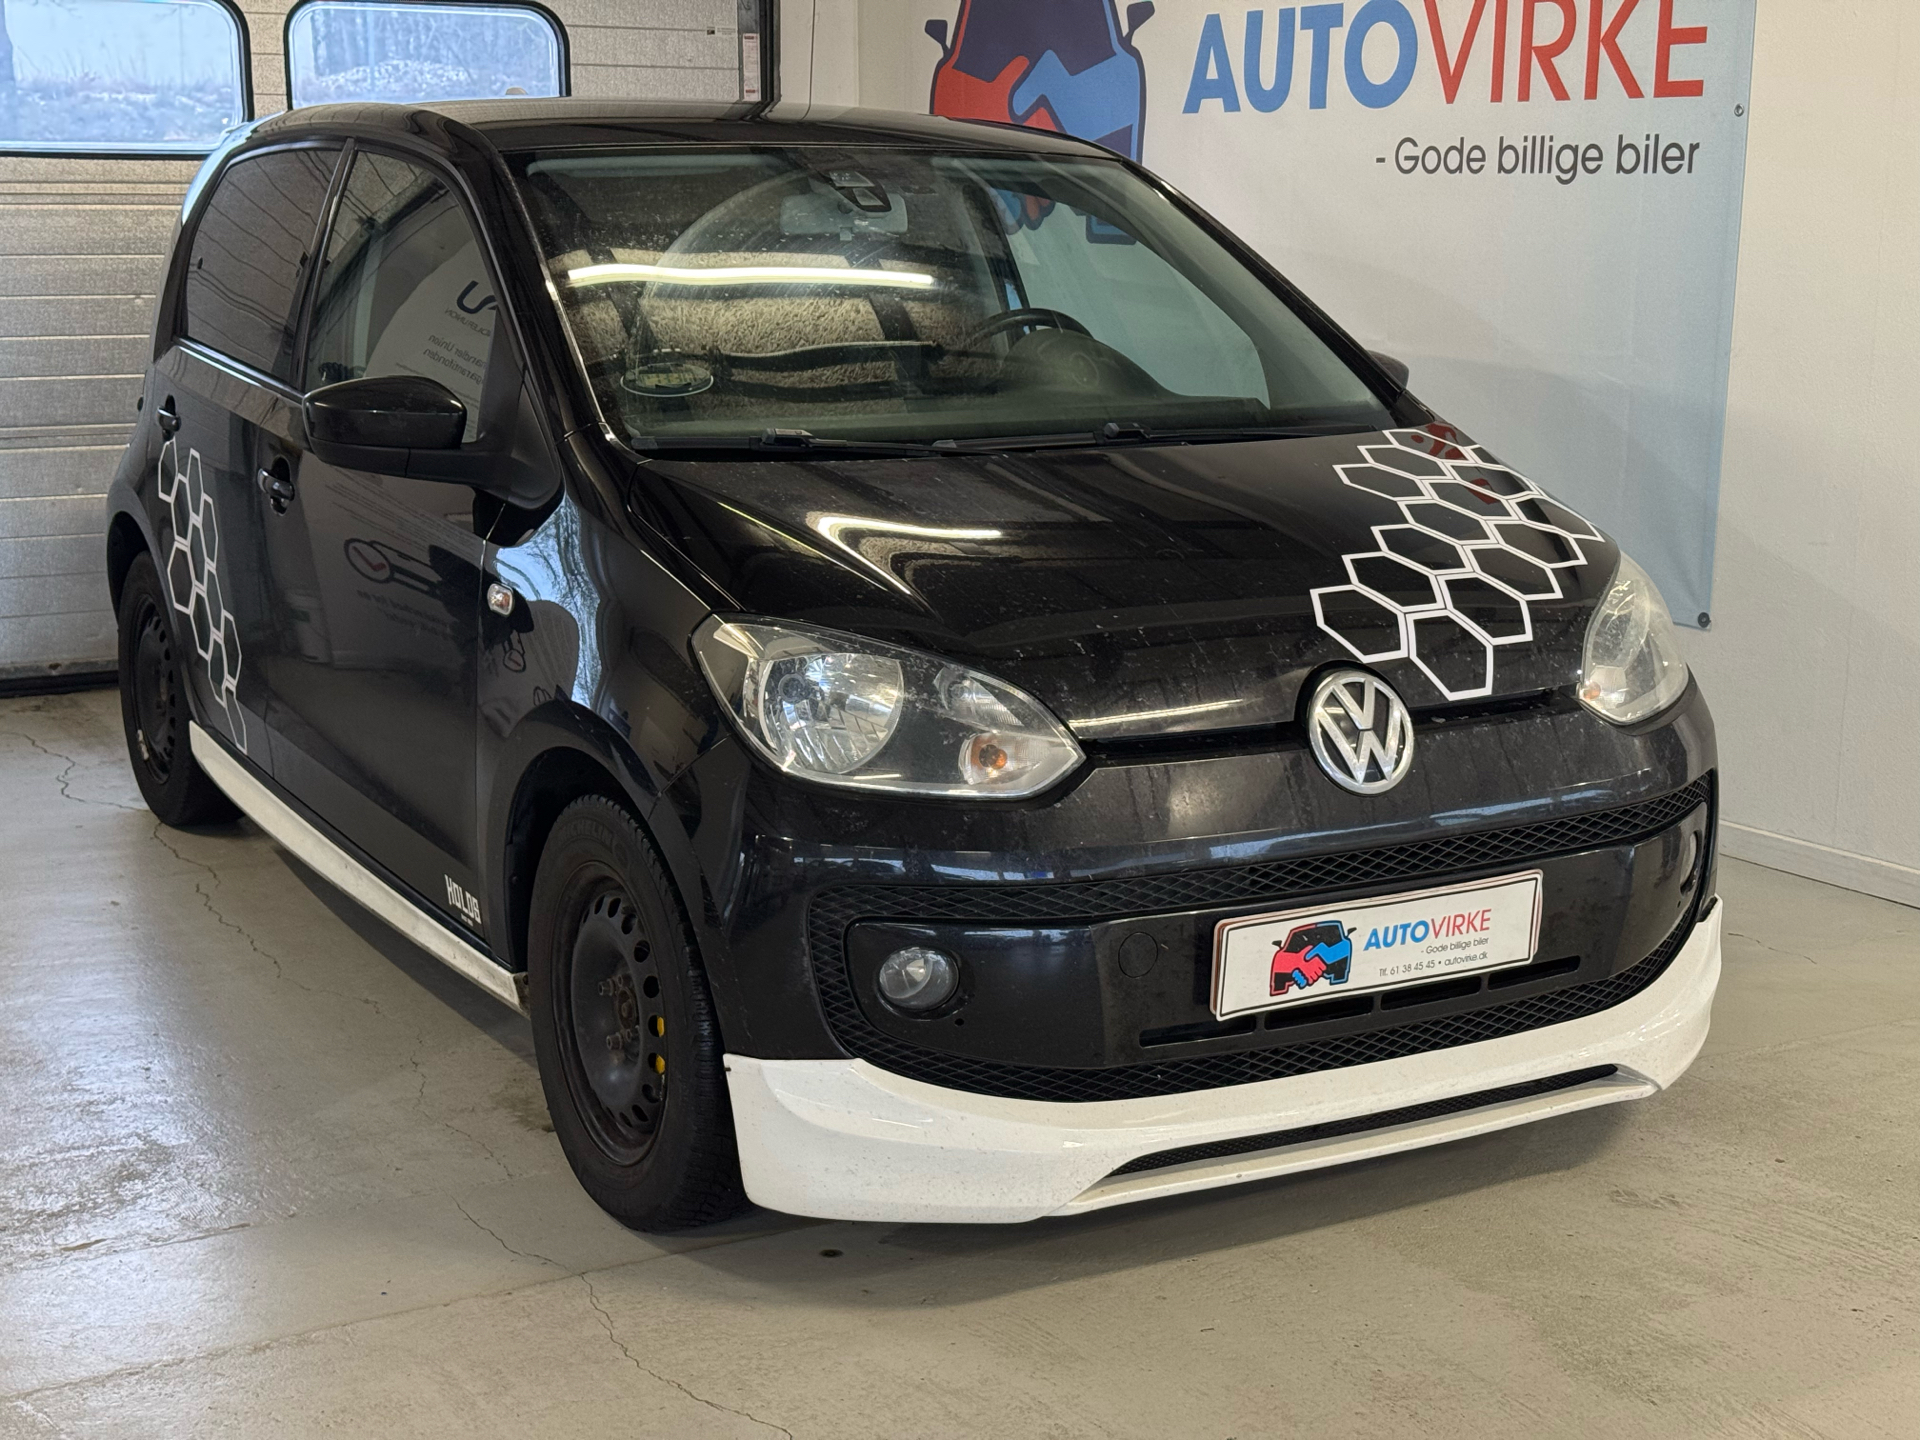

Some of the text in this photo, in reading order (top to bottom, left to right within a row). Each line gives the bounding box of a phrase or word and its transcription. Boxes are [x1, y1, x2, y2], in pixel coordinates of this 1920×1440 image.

[1182, 0, 1708, 114] AUTOVIRKE
[1393, 137, 1486, 175] Gode
[1498, 135, 1603, 185] billige
[1616, 134, 1701, 174] biler
[1363, 908, 1492, 951] AUTOVIRKE
[1426, 943, 1448, 954] Gode
[1449, 940, 1472, 951] billige
[1473, 937, 1489, 947] biler
[1390, 966, 1399, 975] 61
[1402, 963, 1412, 973] 38
[1414, 961, 1424, 971] 45
[1425, 959, 1435, 969] 45
